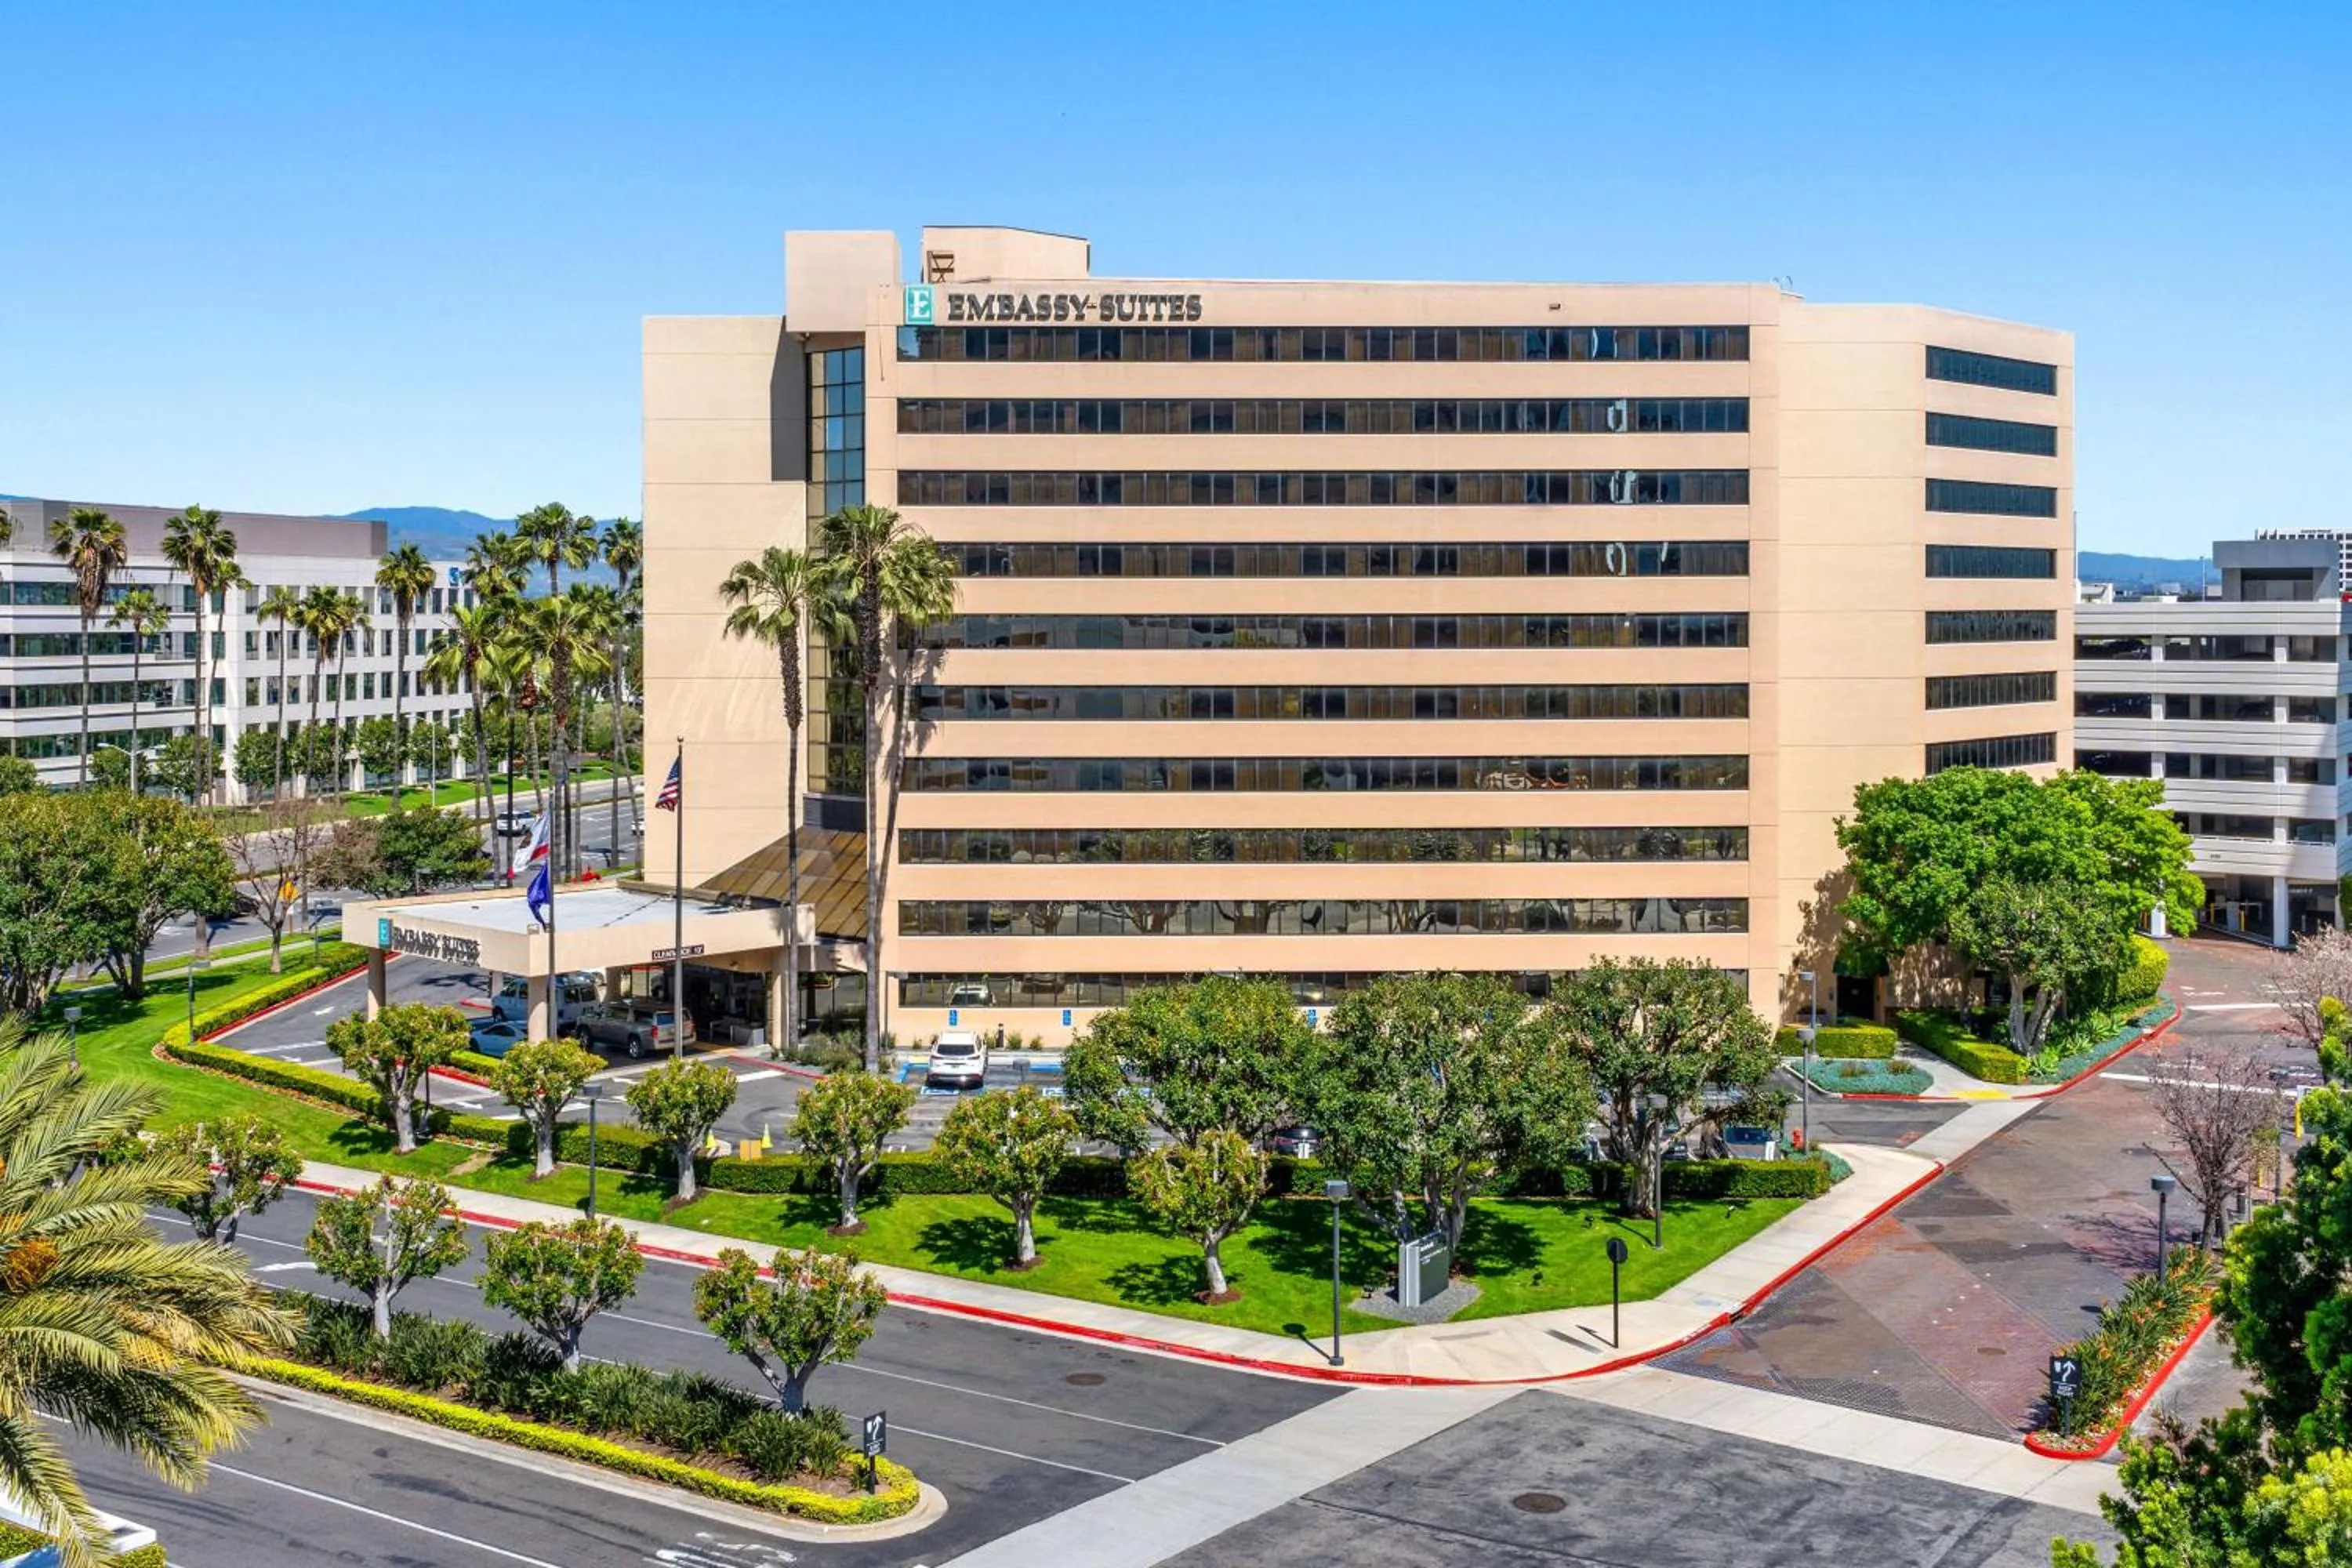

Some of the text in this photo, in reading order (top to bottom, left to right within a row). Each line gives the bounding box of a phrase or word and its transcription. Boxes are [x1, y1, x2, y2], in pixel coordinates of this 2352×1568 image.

[912, 289, 1202, 322] E EMBASSY SUITES
[392, 927, 441, 953] EMBASSY
[442, 935, 480, 957] SUITES
